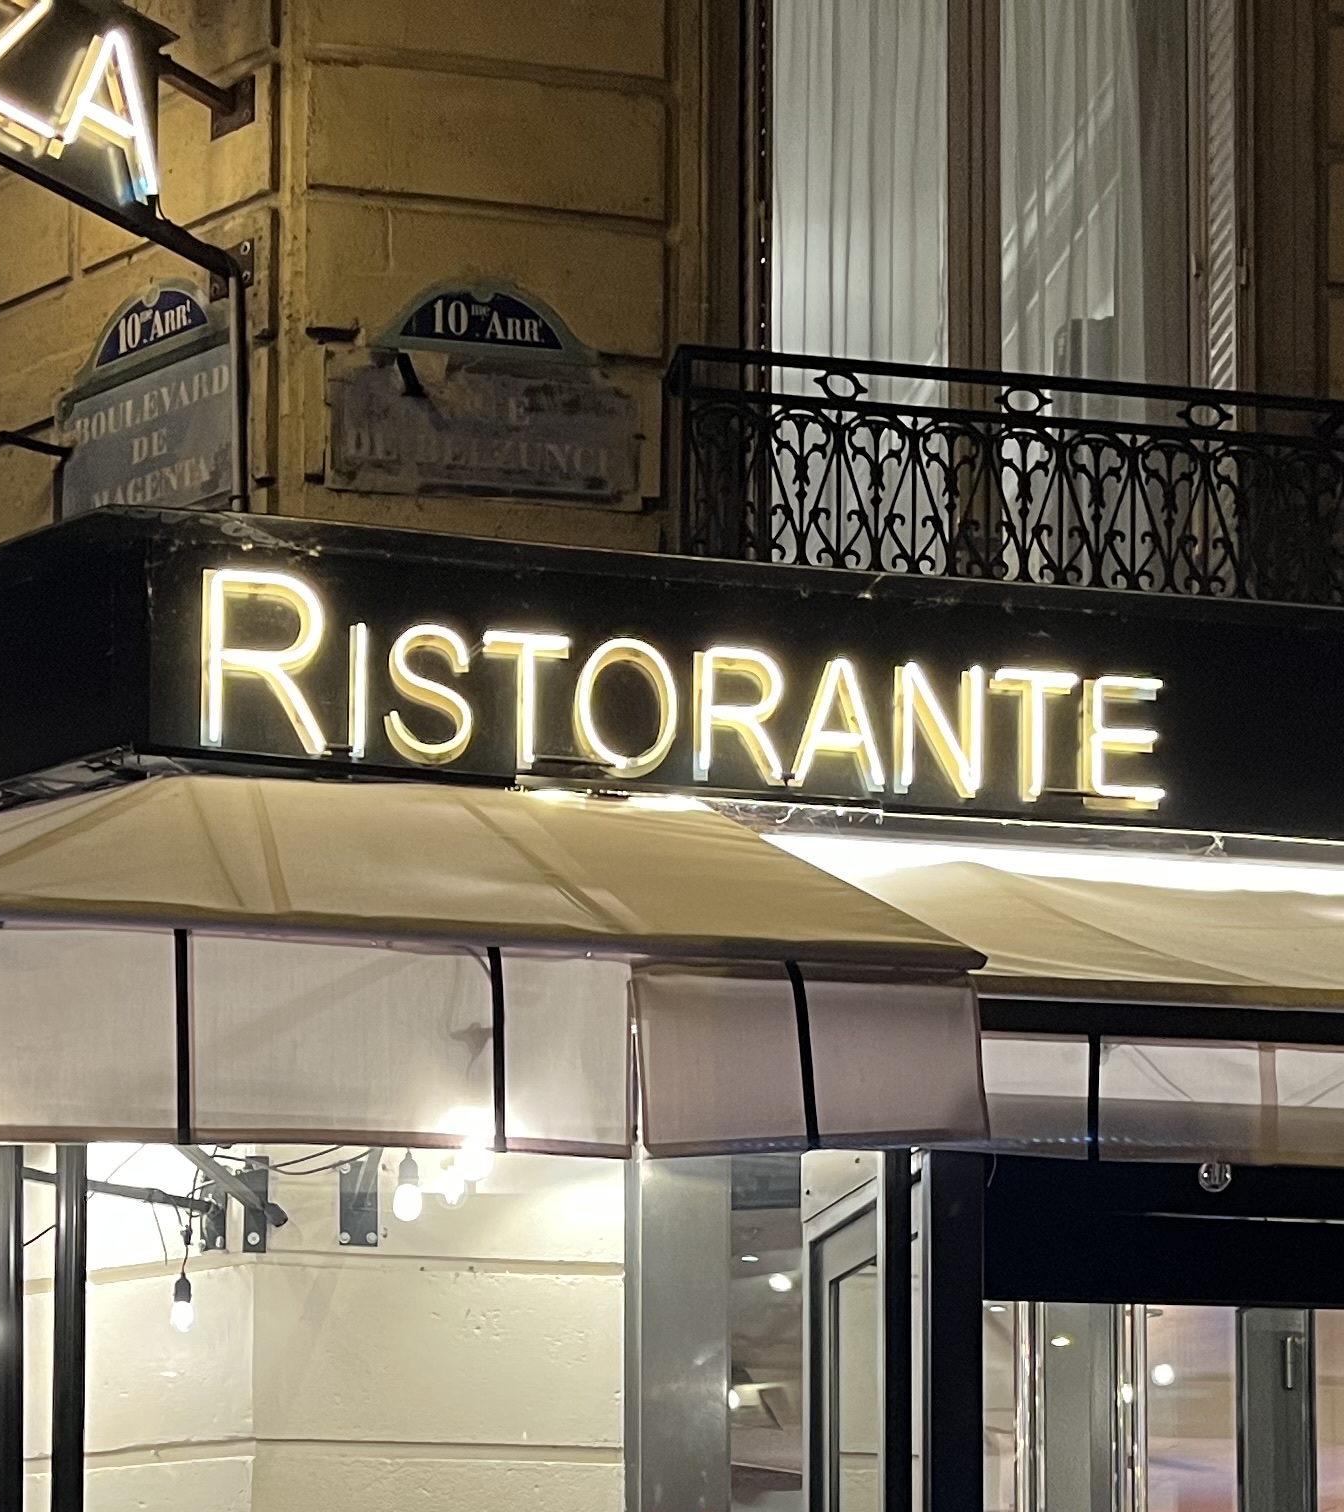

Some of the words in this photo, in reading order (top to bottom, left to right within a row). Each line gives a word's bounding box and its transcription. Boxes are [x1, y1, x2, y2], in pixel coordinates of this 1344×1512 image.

[75, 364, 230, 445] BOULEVARD
[130, 429, 169, 465] DE
[201, 568, 1164, 811] RISTORANTE
